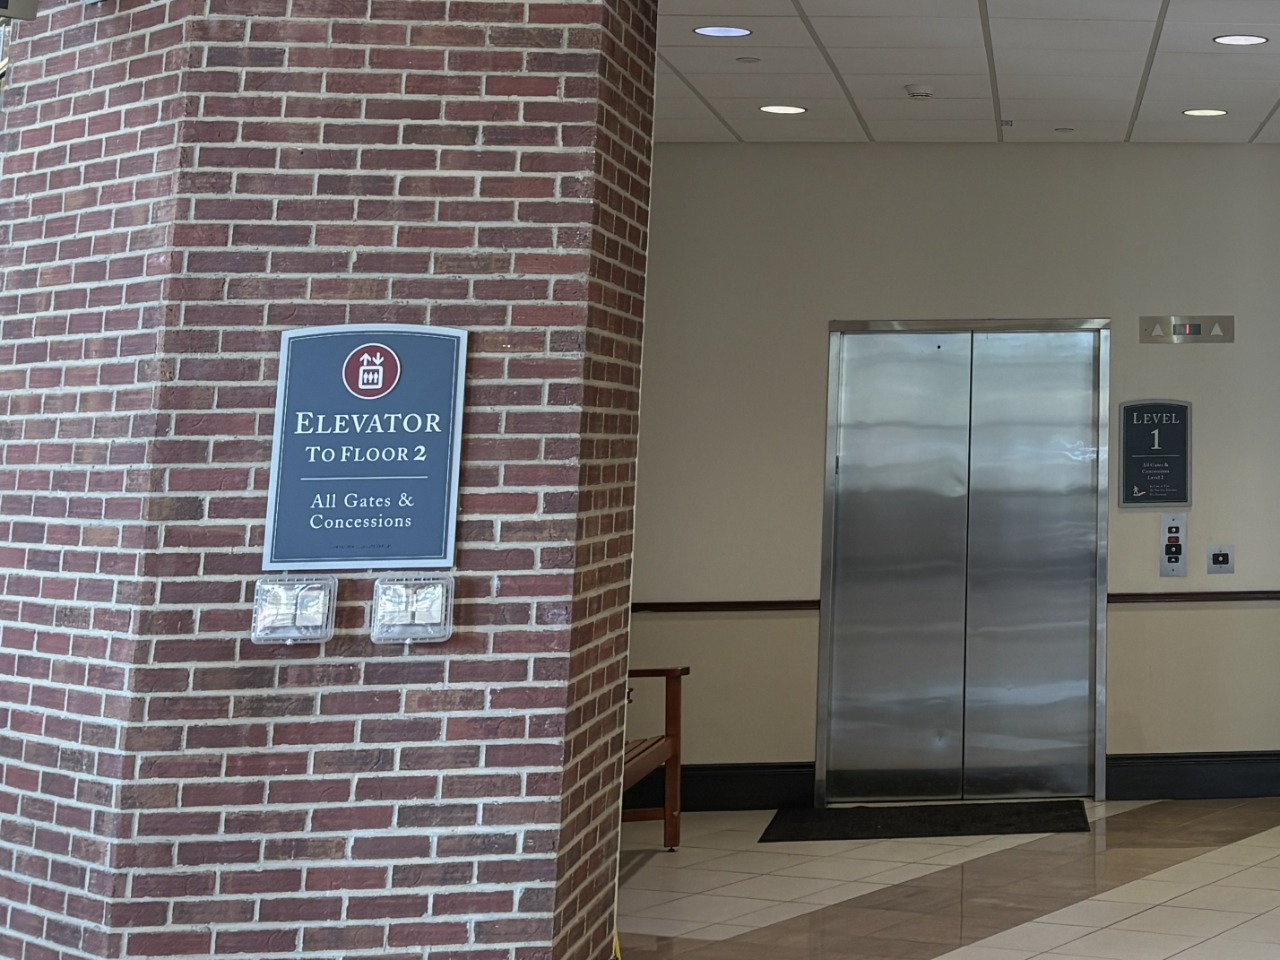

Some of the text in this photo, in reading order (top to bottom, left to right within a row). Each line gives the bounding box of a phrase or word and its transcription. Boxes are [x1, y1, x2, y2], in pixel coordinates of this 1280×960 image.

[294, 412, 441, 434] ELEVATOR
[1133, 413, 1180, 424] LEVEL
[1151, 428, 1162, 449] 1
[306, 445, 426, 463] TO FLOOR 2
[310, 493, 414, 508] All Gates &
[310, 514, 412, 529] Concessions
